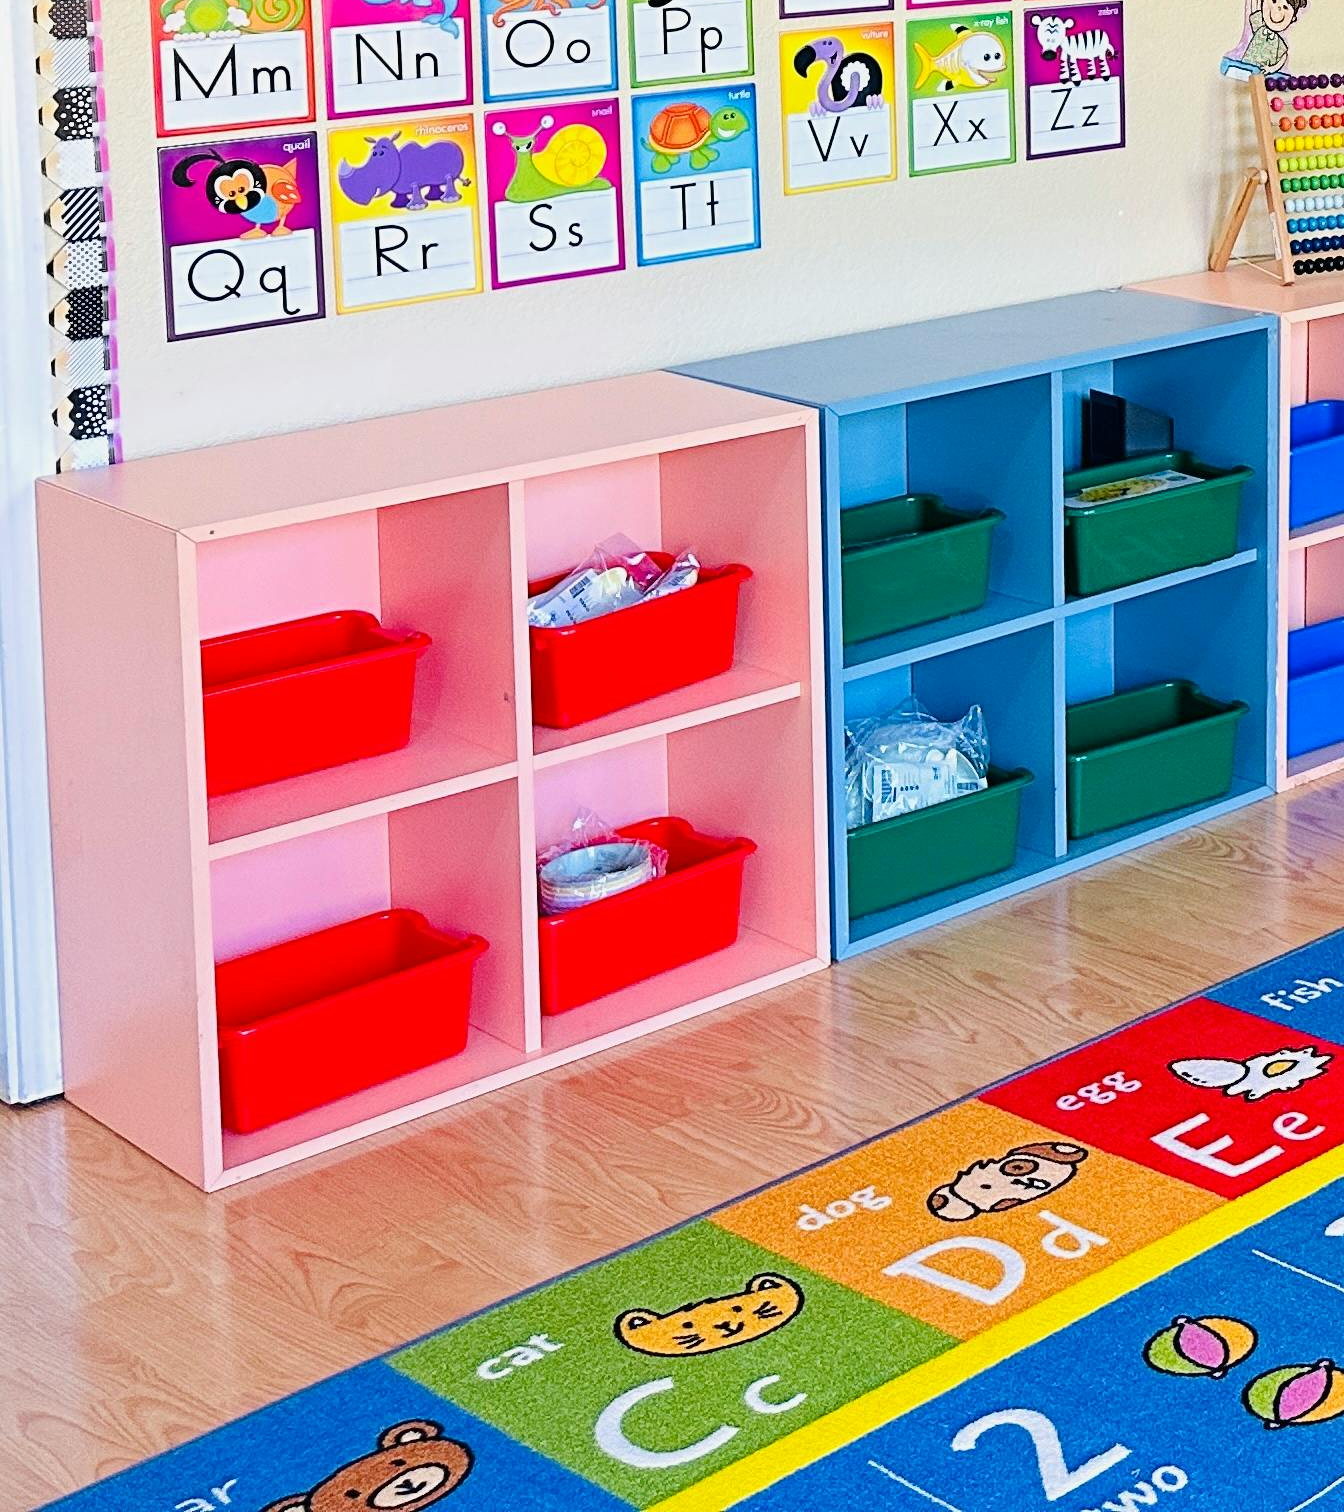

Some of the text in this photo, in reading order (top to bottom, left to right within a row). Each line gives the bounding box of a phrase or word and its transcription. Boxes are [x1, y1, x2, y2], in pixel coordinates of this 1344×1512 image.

[282, 137, 311, 154] quail
[1259, 972, 1344, 1014] fish
[1054, 1068, 1141, 1116] egg
[795, 1183, 890, 1234] dog
[474, 1327, 566, 1385] cat
[951, 1405, 1131, 1504] 2
